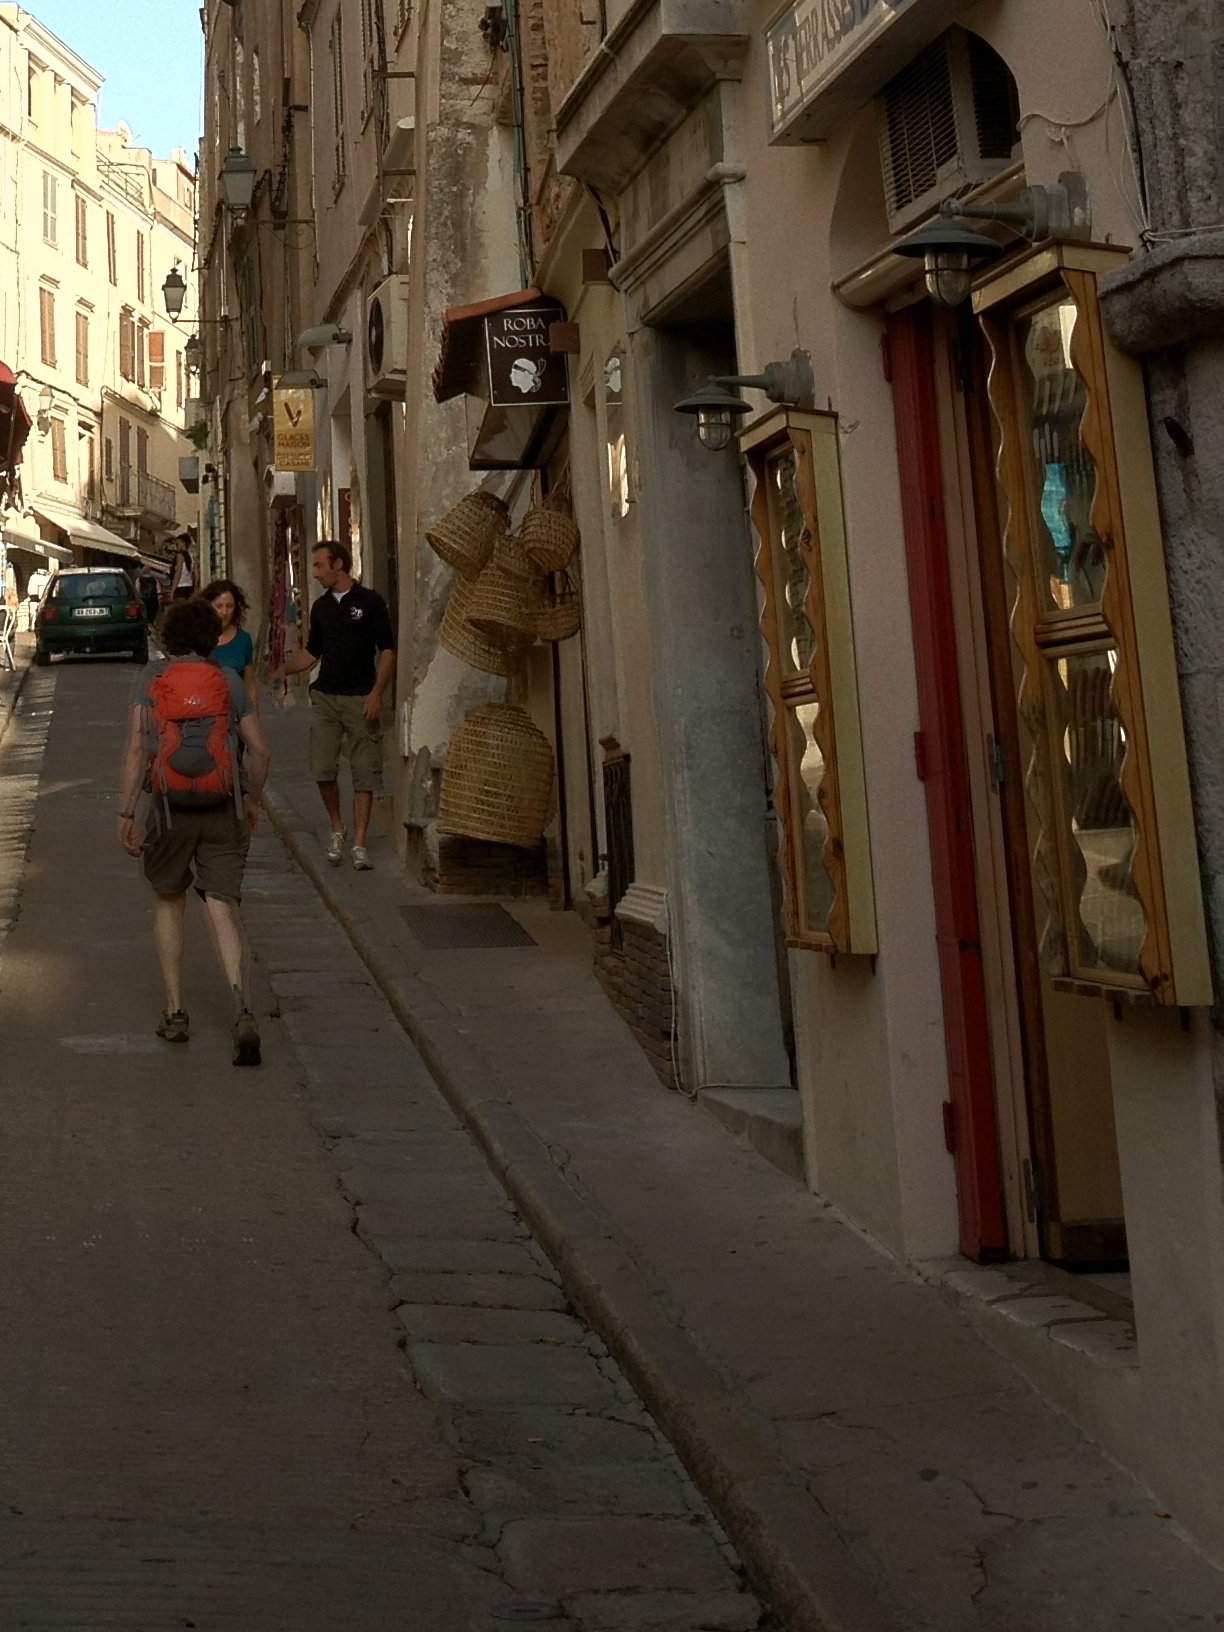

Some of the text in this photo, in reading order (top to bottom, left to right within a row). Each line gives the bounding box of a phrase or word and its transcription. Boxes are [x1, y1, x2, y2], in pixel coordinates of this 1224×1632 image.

[503, 317, 546, 332] ROBA
[493, 333, 550, 349] NOSTR
[278, 433, 310, 441] GLACES
